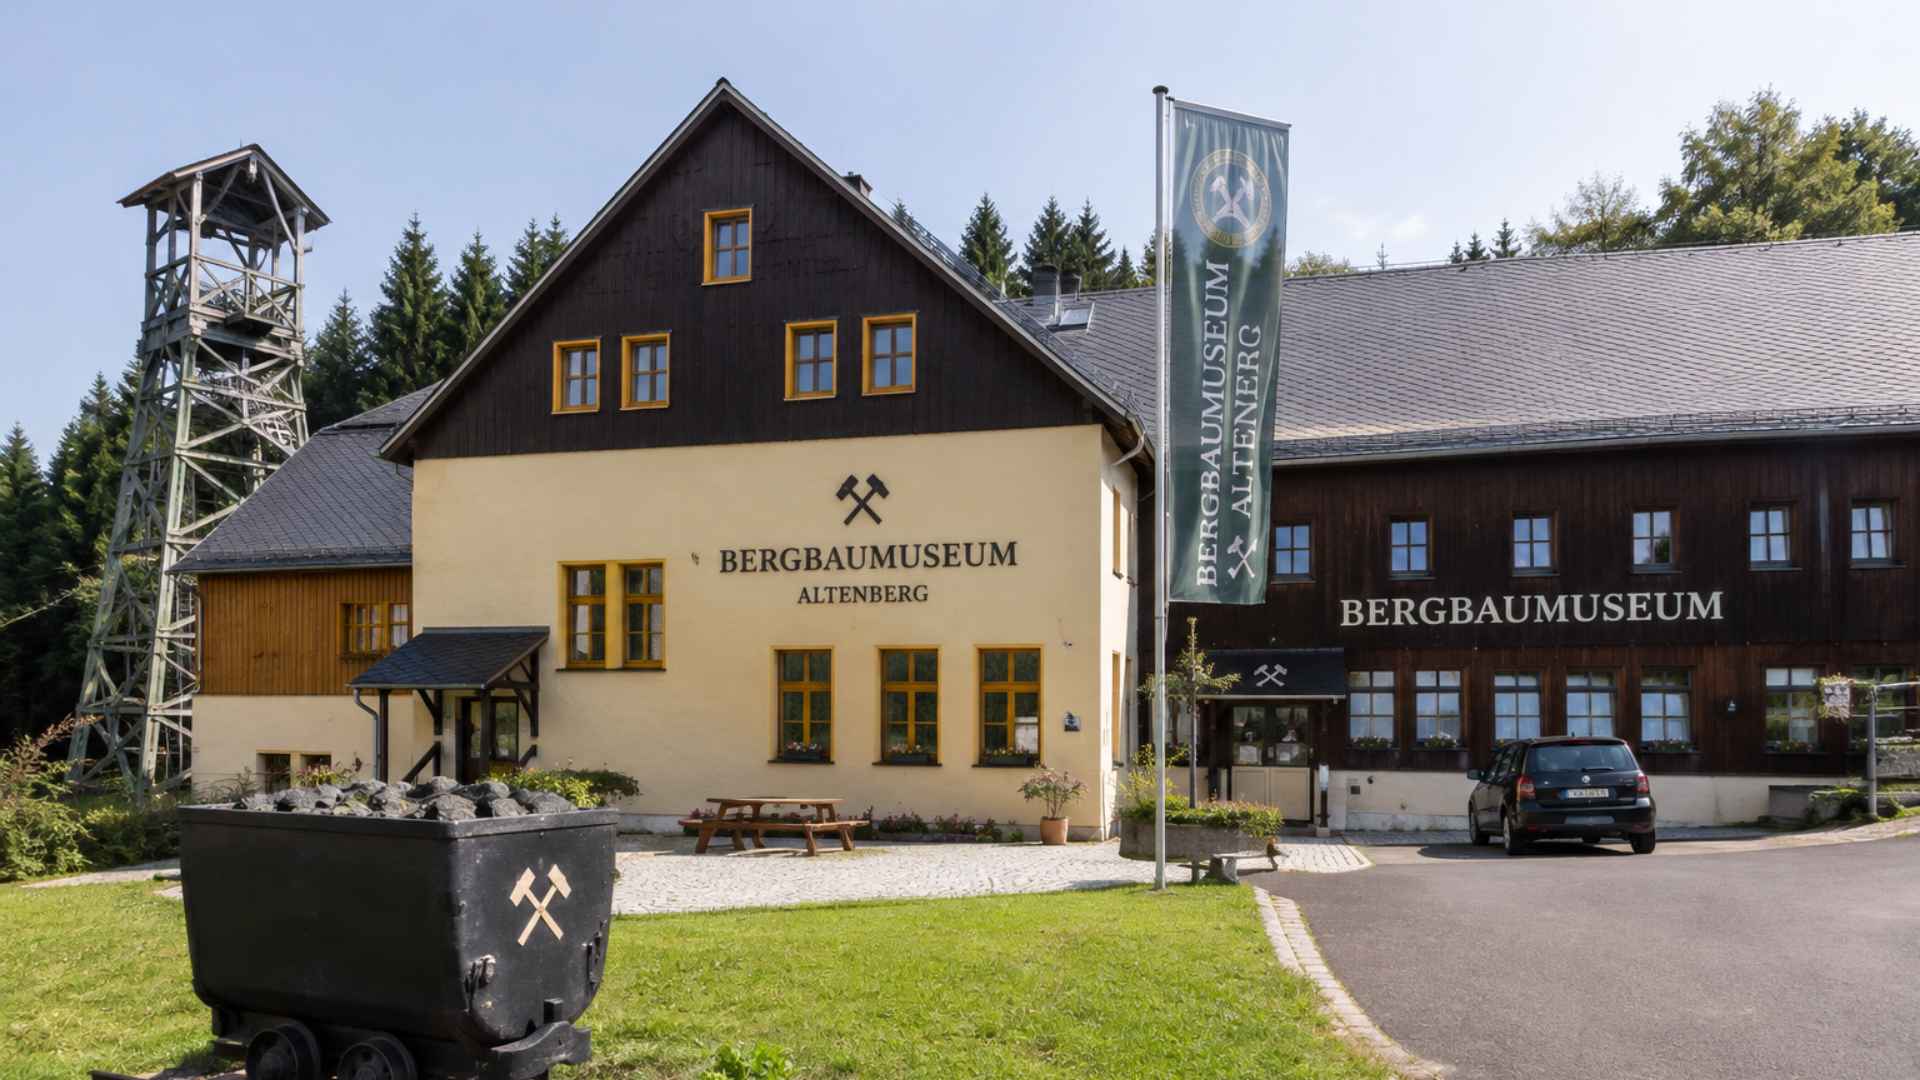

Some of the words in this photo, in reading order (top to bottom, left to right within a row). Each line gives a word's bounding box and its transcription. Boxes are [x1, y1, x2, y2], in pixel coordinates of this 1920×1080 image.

[1197, 259, 1230, 588] BERGBAUMUSEUM
[1231, 324, 1262, 520] ALTENERG
[720, 541, 1018, 574] BERGBAUMUSEUM
[797, 584, 929, 605] ALTENBERG
[1340, 591, 1723, 626] BERGBAUMUSEUM
